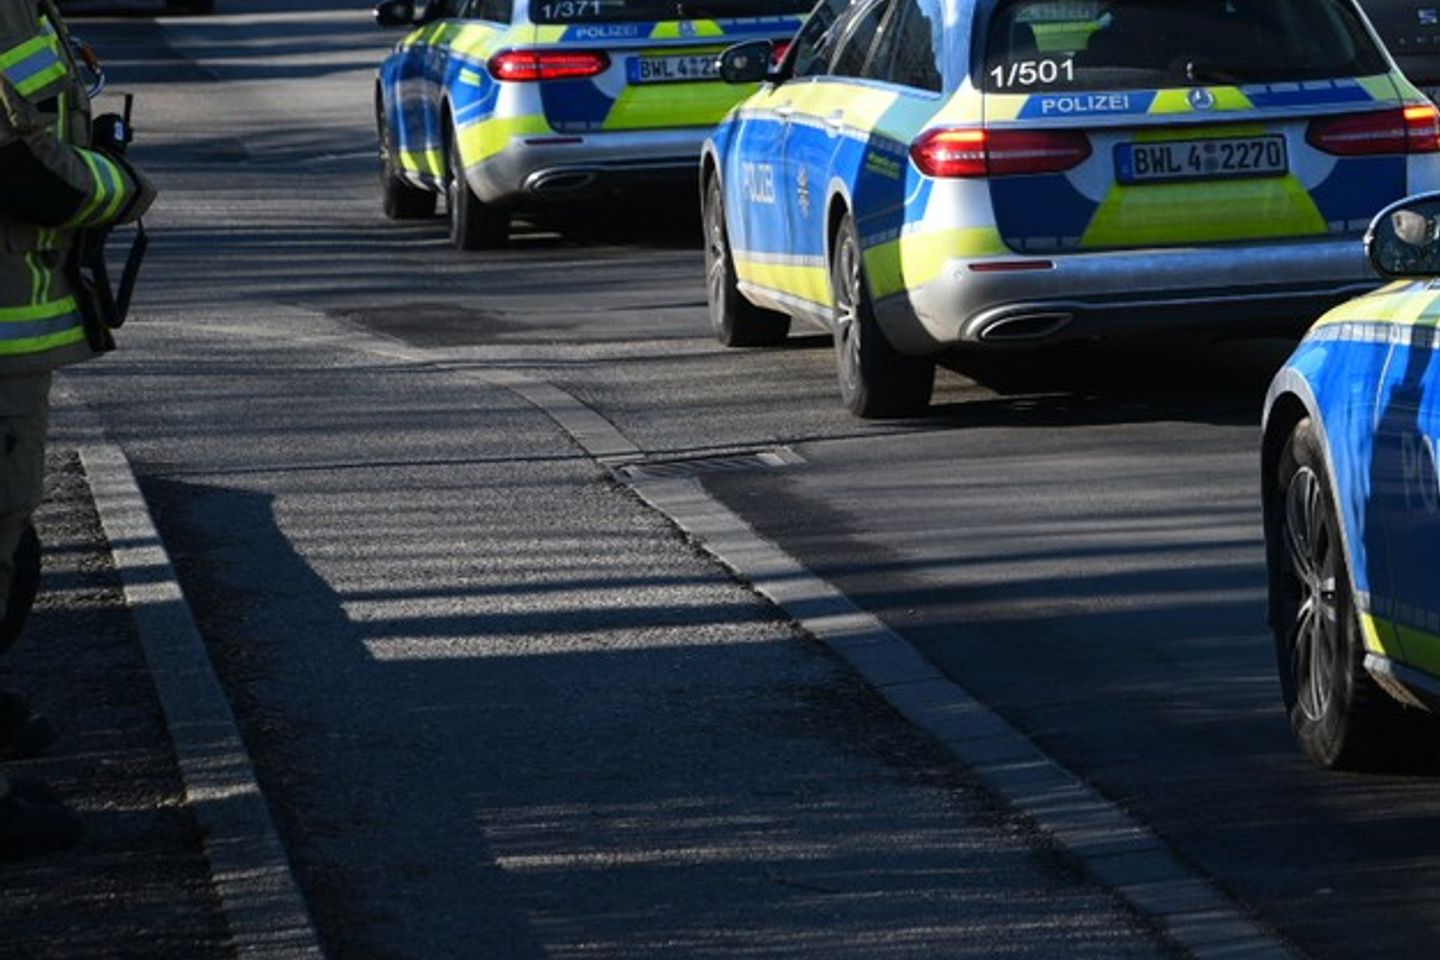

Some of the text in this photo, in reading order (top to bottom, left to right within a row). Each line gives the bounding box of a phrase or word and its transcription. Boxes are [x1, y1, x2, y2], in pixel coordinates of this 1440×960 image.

[541, 0, 601, 19] 1/371
[575, 25, 639, 38] POLIZEI
[639, 59, 675, 79] BWL
[677, 58, 689, 76] 4
[989, 58, 1076, 88] 1/501
[1041, 94, 1130, 114] POLIZEI
[1134, 140, 1282, 176] BWL 4 2270
